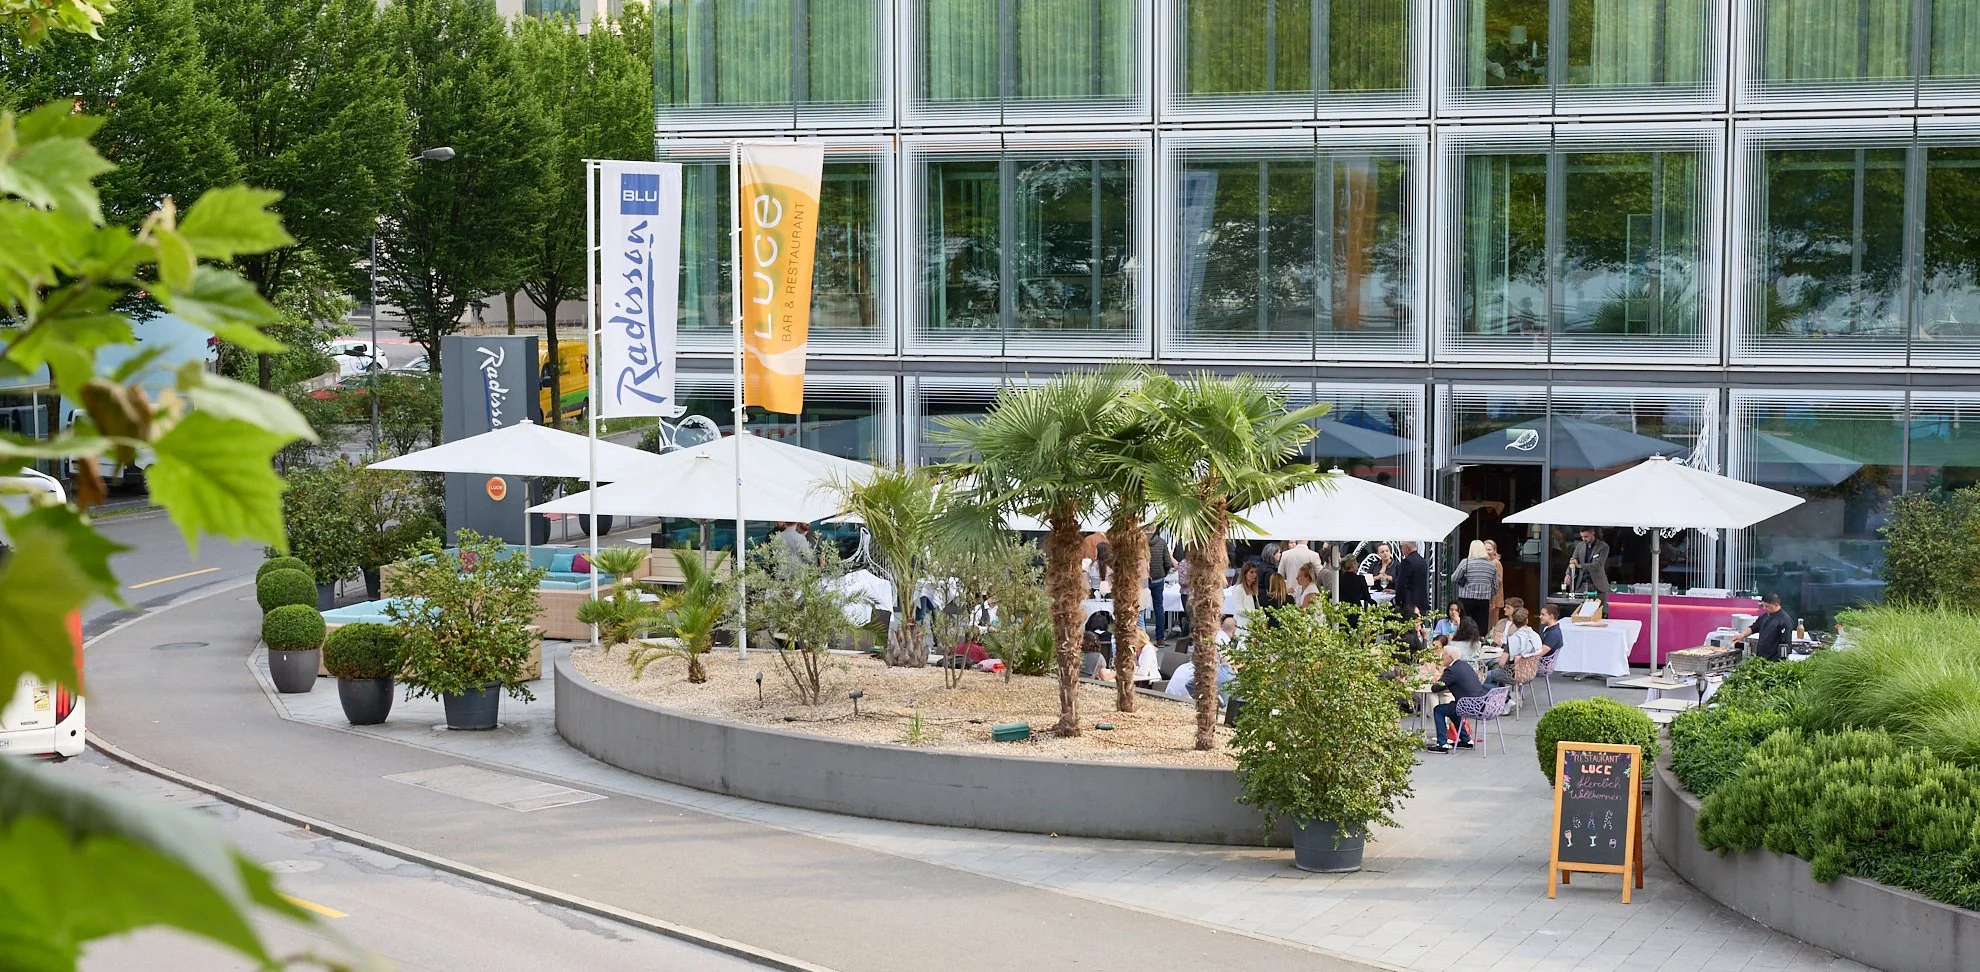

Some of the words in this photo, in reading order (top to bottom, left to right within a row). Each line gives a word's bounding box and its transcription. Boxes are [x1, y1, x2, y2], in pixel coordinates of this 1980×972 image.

[622, 189, 658, 202] BLU
[785, 201, 806, 295] RESTAURANT
[608, 220, 668, 406] Radisson
[784, 301, 795, 309] &
[781, 313, 793, 342] BAR
[476, 346, 510, 428] Radisso
[1573, 754, 1620, 763] RESTAURANT
[1581, 764, 1612, 775] LUCE
